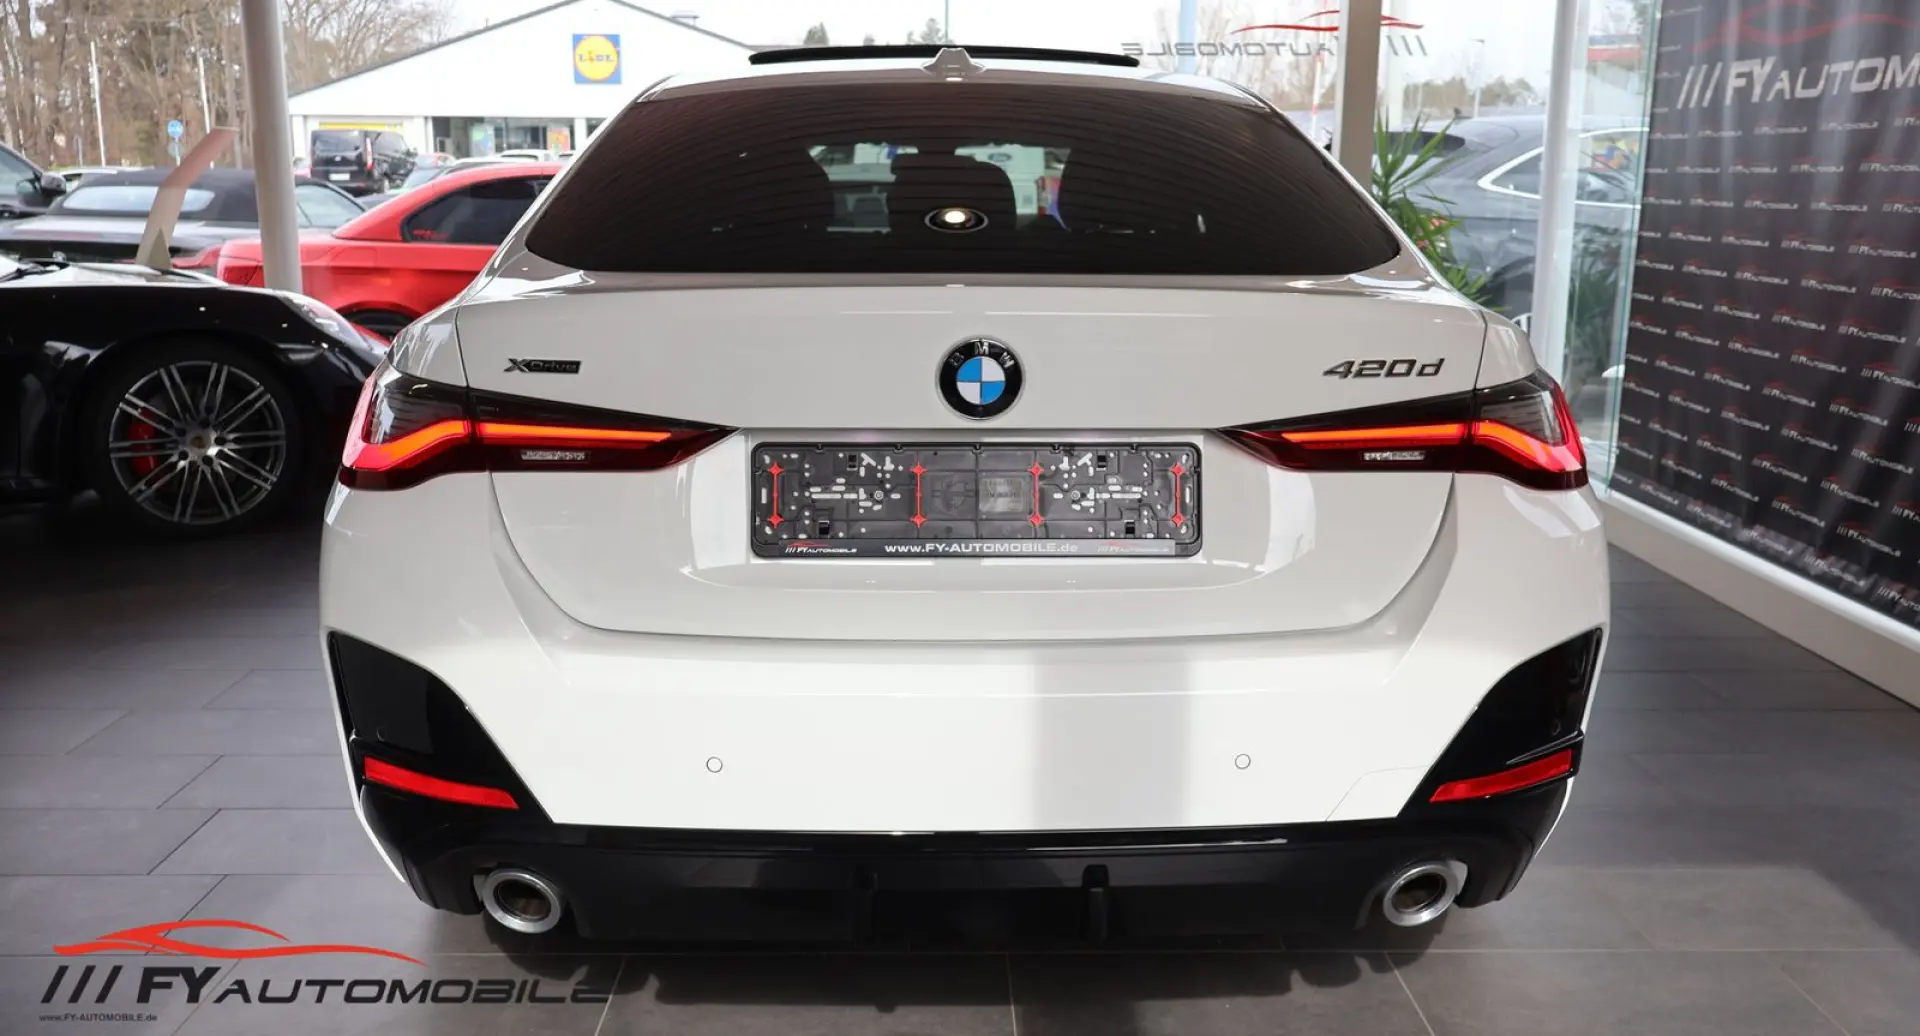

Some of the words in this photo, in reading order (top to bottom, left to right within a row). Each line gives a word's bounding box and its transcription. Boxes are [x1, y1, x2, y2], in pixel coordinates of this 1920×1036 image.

[1724, 53, 1920, 106] FYAUTOM
[950, 340, 1015, 366] BMW
[1322, 358, 1446, 379] 420d
[884, 542, 1078, 553] www.FY-AUTOMOBILE.de
